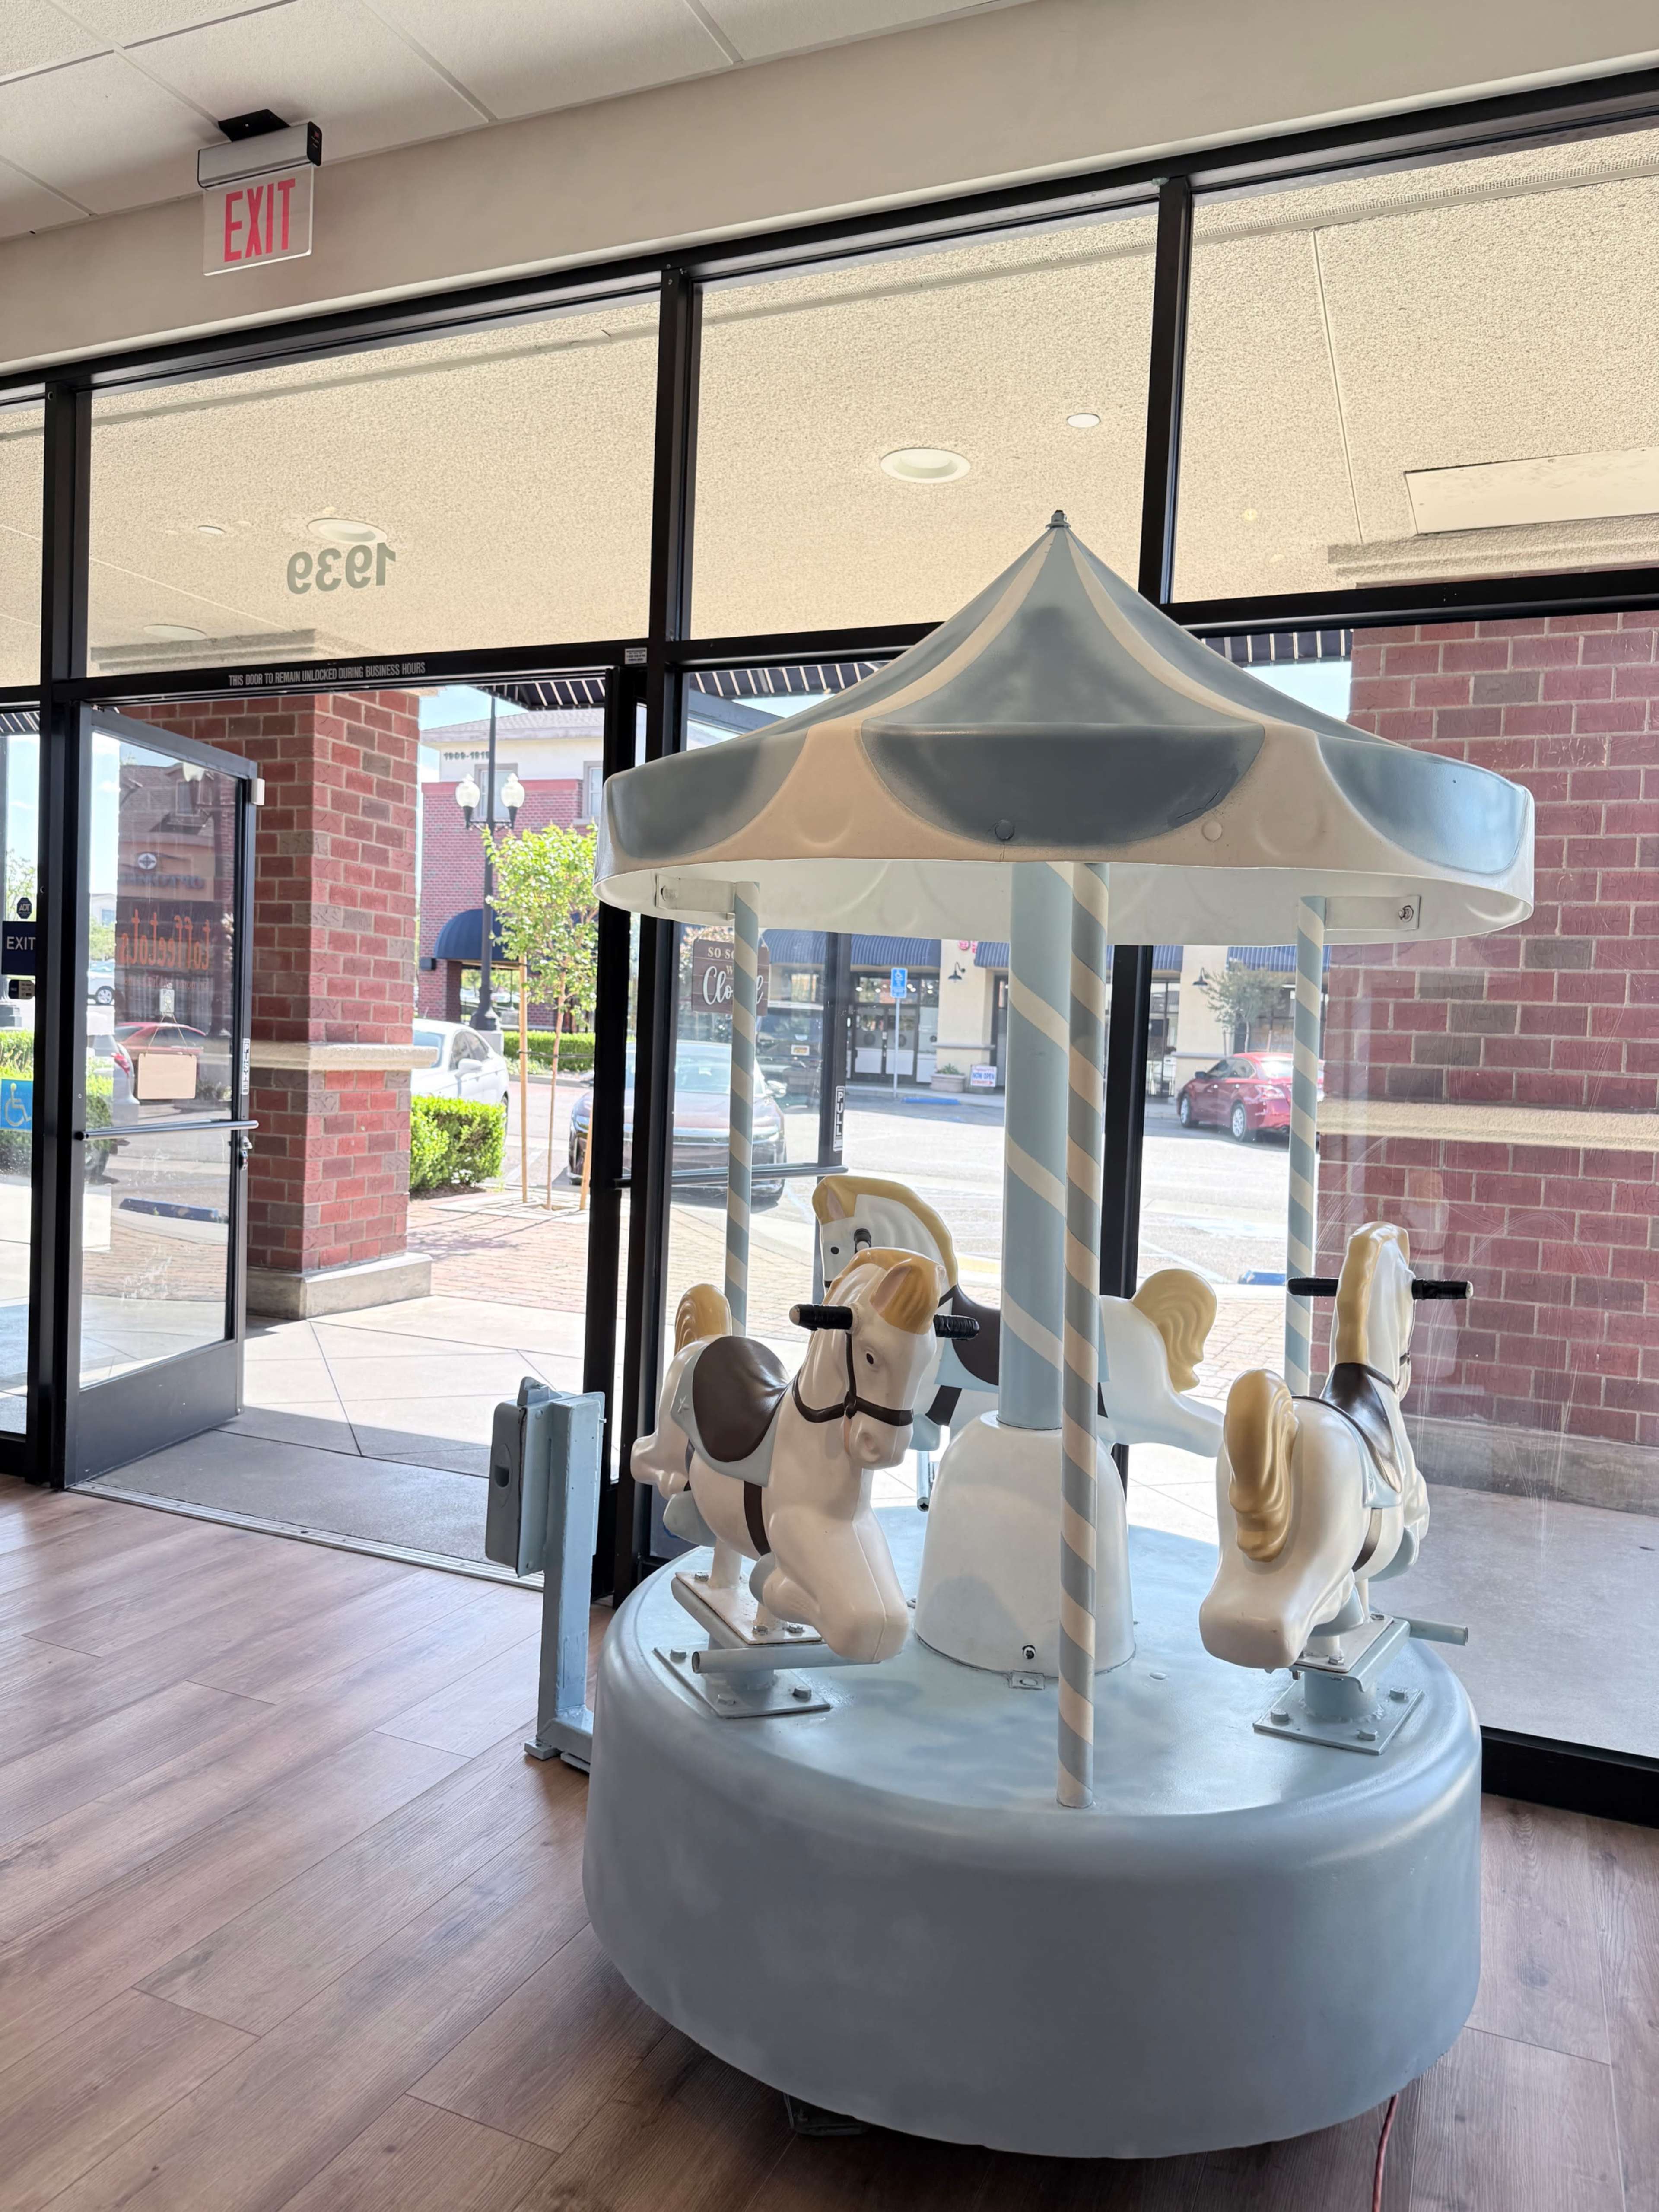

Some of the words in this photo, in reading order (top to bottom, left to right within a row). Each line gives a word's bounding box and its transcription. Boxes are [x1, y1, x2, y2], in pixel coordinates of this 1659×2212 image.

[224, 178, 296, 262] EXIT
[229, 675, 244, 686] THIS
[245, 674, 263, 685] DOOR
[264, 673, 273, 684] TO
[275, 671, 300, 683] REMAIN
[302, 668, 337, 681] UNLOCKED
[338, 666, 363, 679] DURING
[365, 664, 400, 677] BUSINESS
[402, 662, 426, 675] HOURS
[7, 936, 36, 950] EXIT
[708, 947, 721, 958] SO
